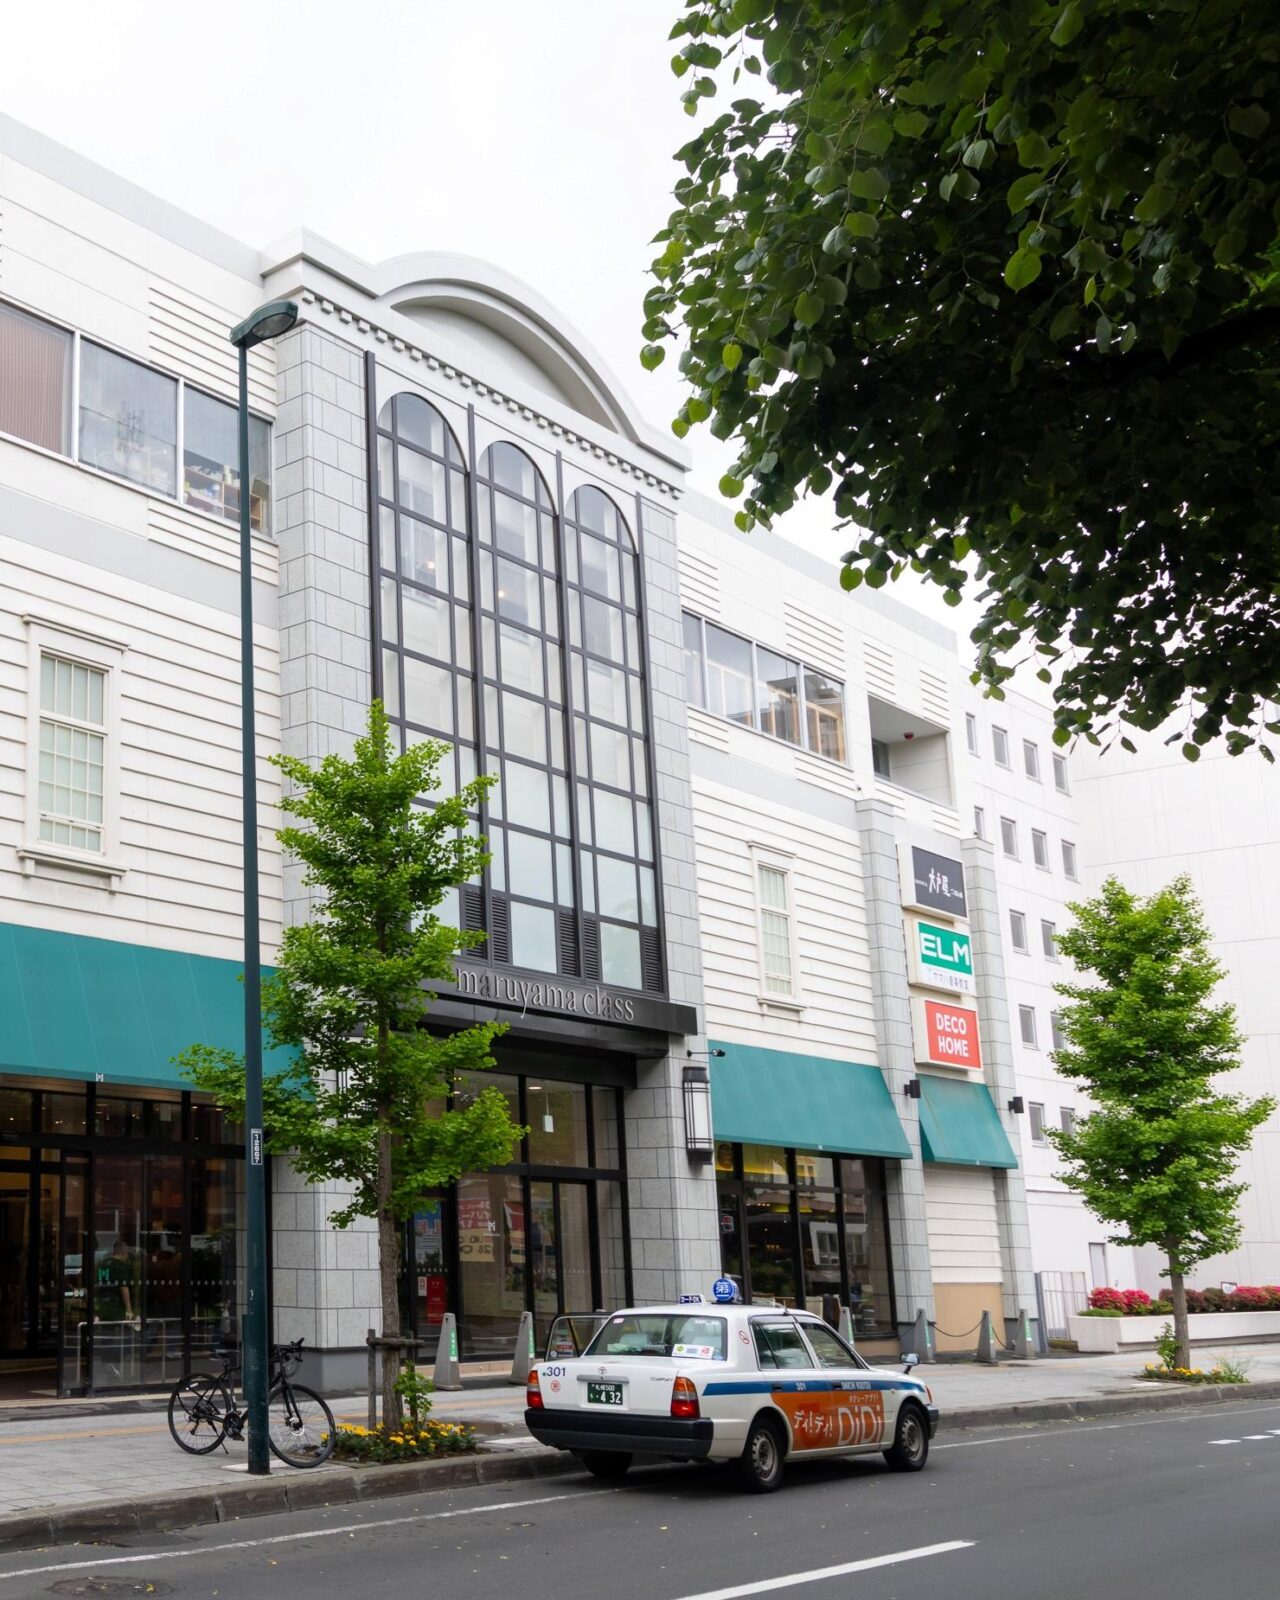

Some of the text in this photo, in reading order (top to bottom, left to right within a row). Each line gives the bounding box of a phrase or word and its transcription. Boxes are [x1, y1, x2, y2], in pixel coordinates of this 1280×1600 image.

[920, 932, 970, 966] ELM
[456, 967, 634, 1022] maruyama class
[935, 1012, 967, 1035] DECO
[937, 1035, 970, 1058] HOME
[546, 1366, 566, 1377] 301
[795, 1382, 807, 1391] 301
[837, 1404, 882, 1446] DiDi
